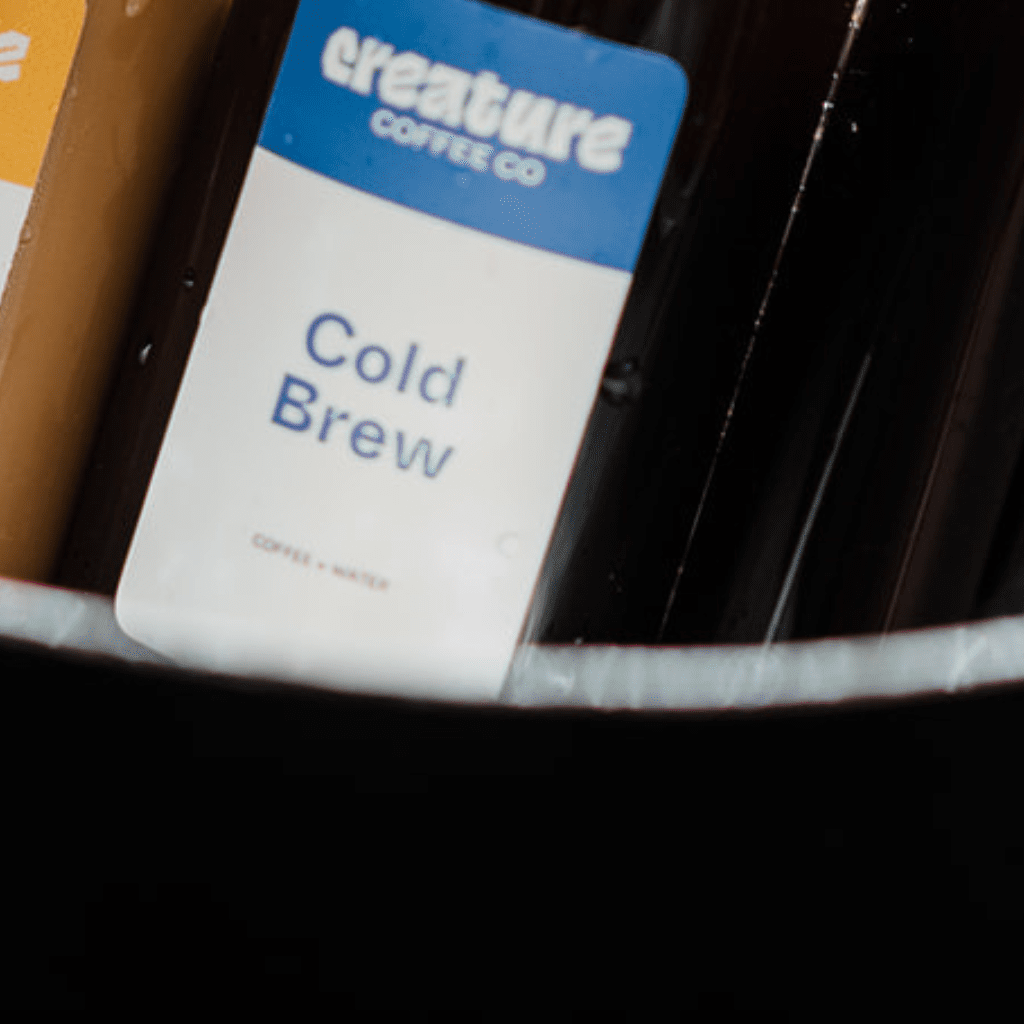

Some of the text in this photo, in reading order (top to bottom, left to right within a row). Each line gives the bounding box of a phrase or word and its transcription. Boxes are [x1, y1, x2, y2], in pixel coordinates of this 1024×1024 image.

[322, 26, 632, 173] creature
[371, 109, 546, 186] COFFEE CO
[305, 311, 467, 408] Cold
[271, 373, 453, 478] Brew
